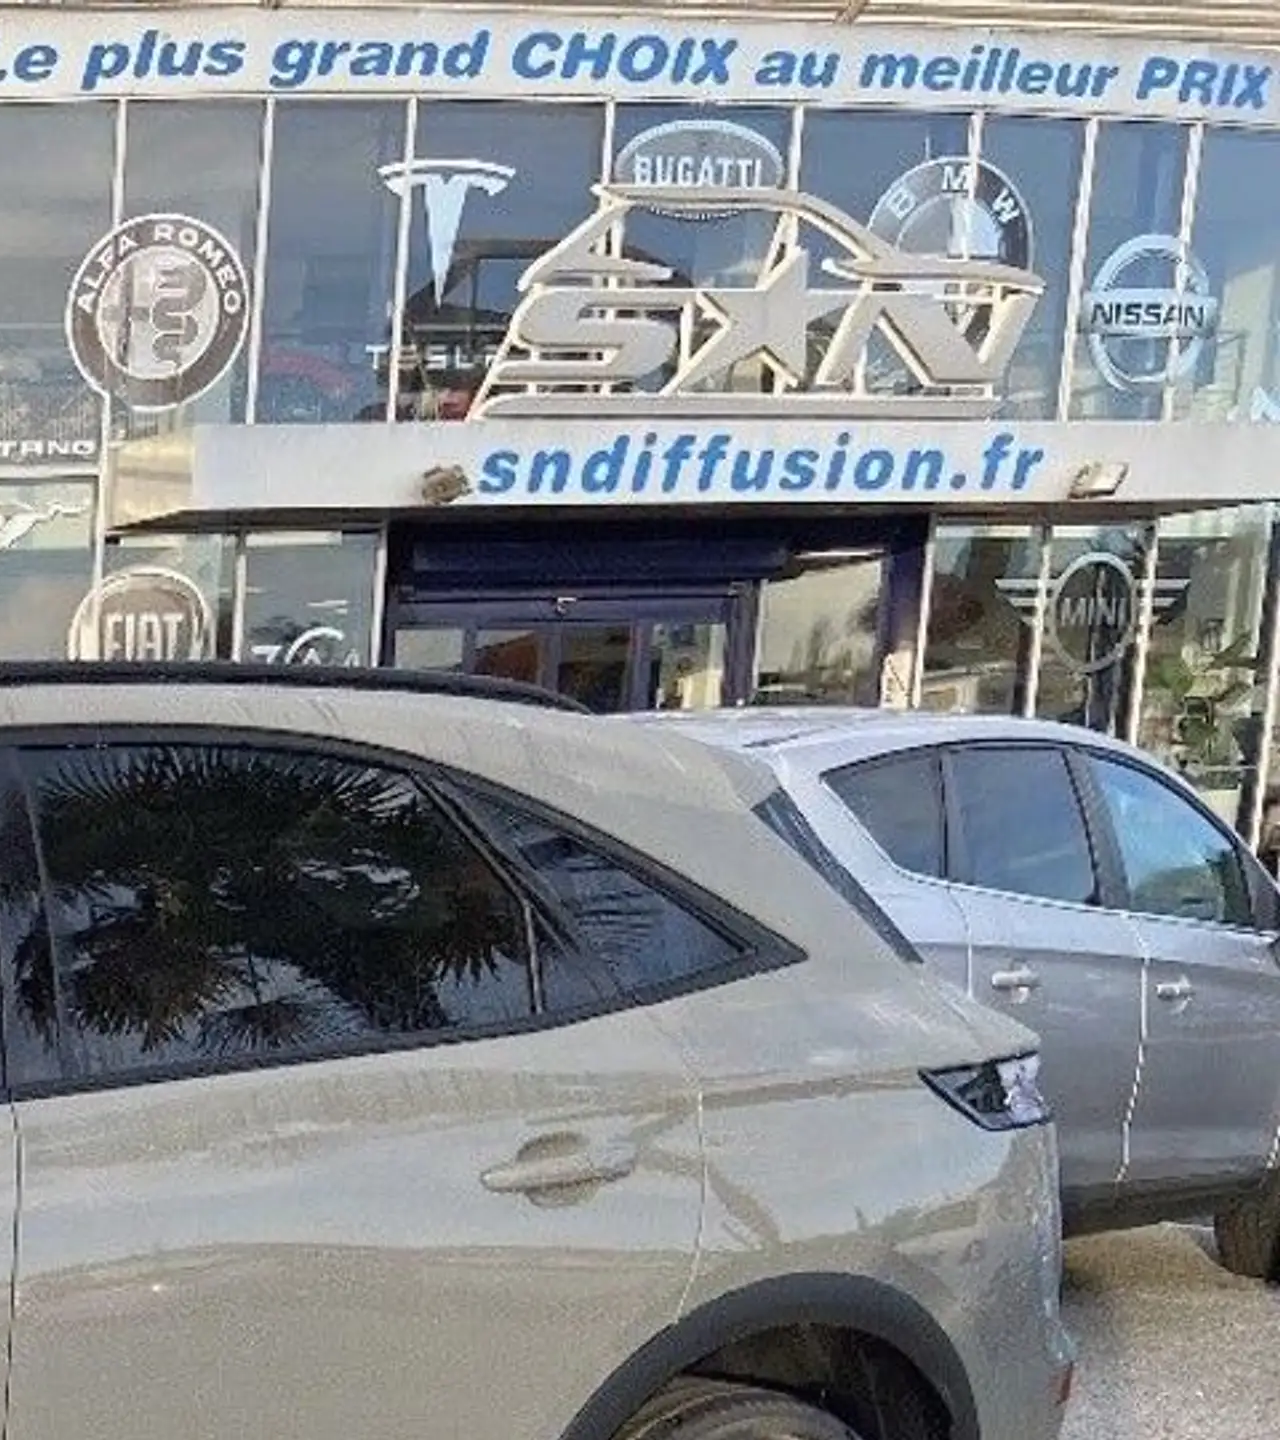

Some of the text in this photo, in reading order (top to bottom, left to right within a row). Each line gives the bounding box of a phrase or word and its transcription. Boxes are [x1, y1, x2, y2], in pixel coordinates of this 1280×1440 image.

[80, 29, 246, 91] plus
[268, 29, 492, 88] grand
[511, 31, 738, 86] CHOIX
[754, 50, 840, 88] au
[858, 45, 1120, 98] meilleur
[1136, 56, 1274, 110] PRIX
[634, 155, 762, 188] BUGATTI
[77, 223, 241, 314] ALFA ROMEO
[1090, 301, 1205, 328] NISSAN
[478, 432, 1044, 494] sndiffusion.fr
[104, 611, 185, 662] FIAT
[1060, 597, 1128, 628] MINI
